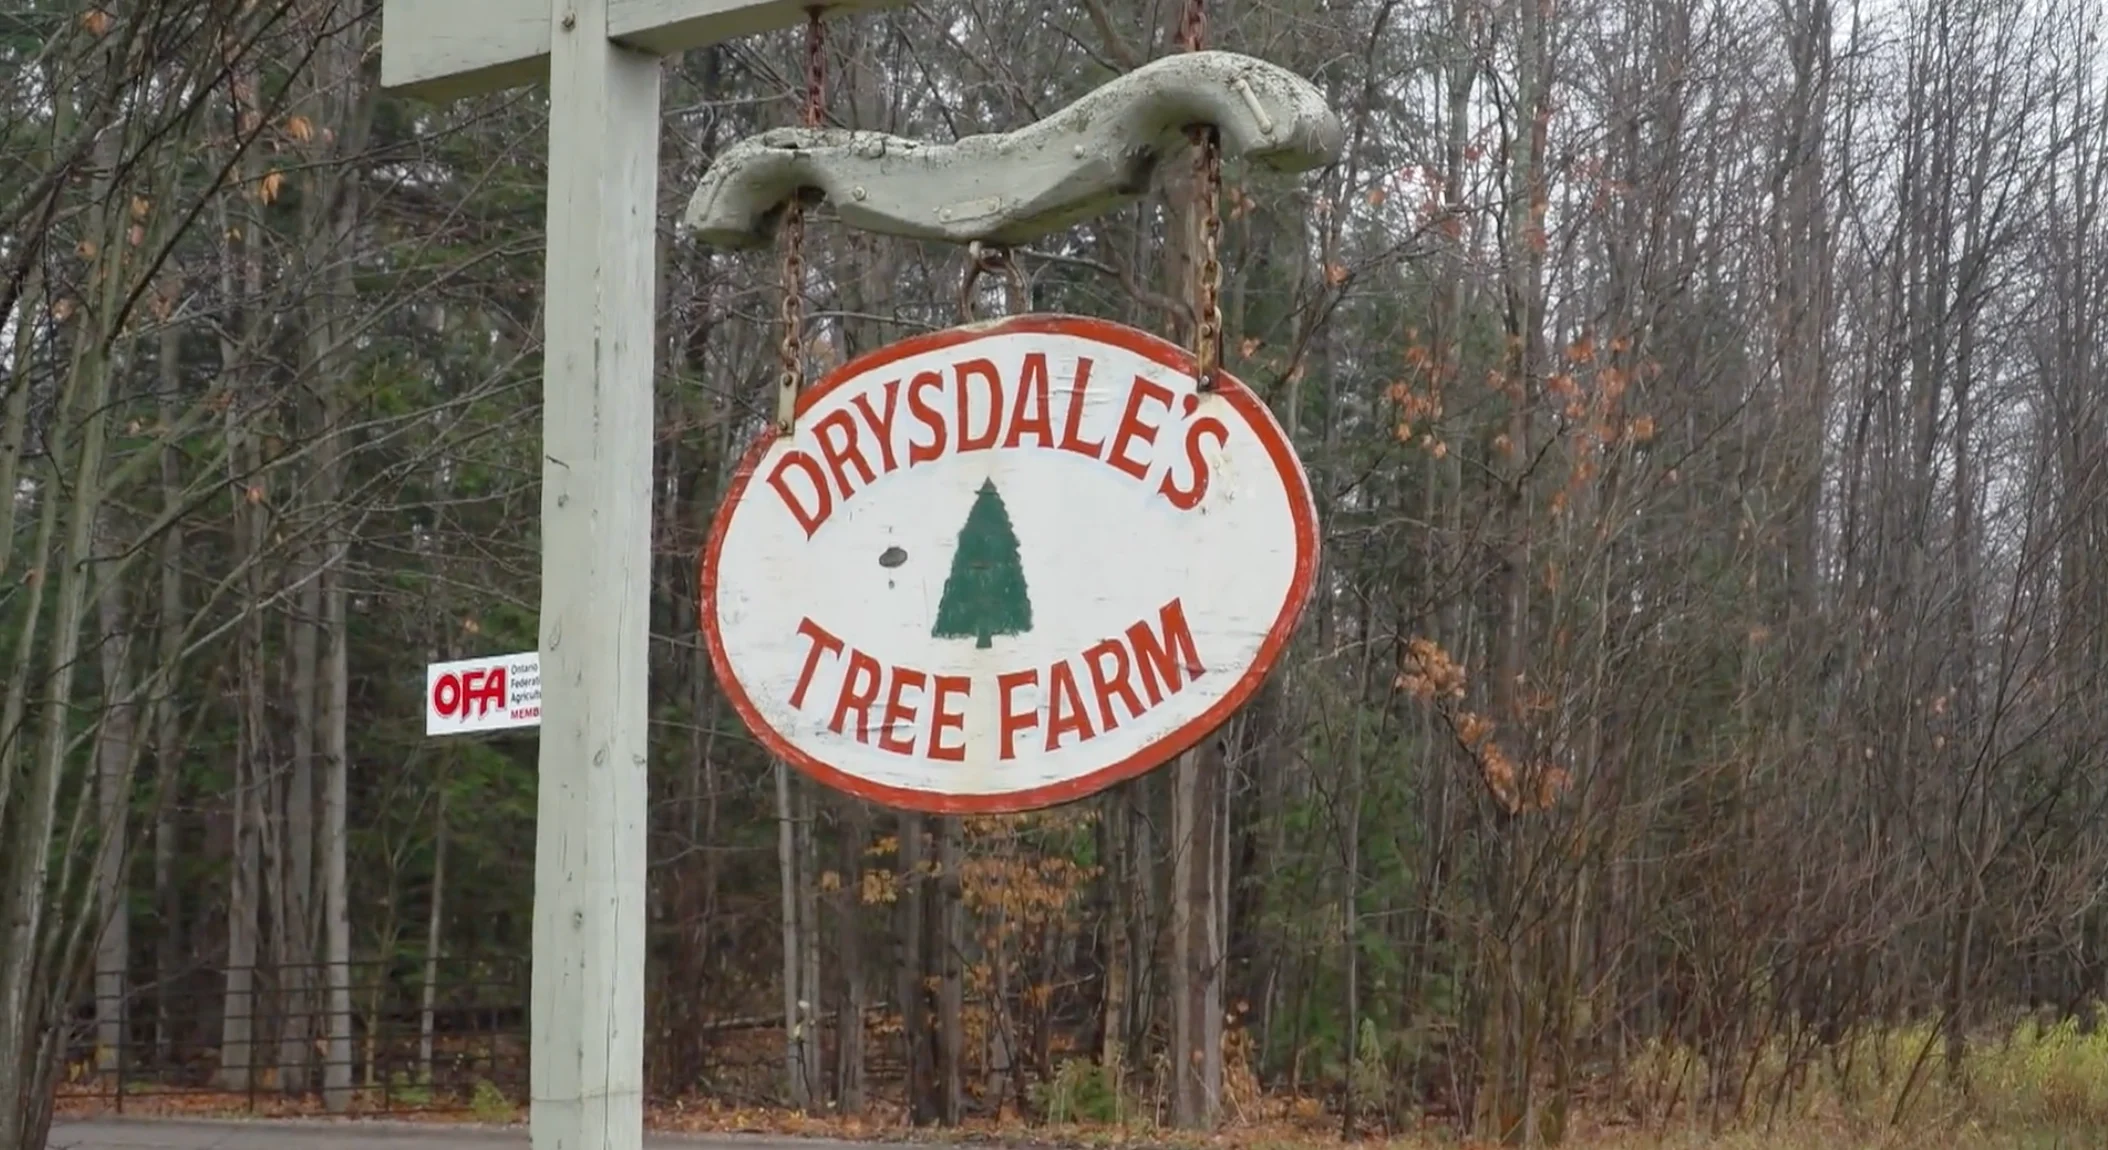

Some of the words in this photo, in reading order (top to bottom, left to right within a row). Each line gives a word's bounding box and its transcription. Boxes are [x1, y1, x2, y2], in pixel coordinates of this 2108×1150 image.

[766, 352, 1228, 540] DRYSDALE'S
[432, 666, 506, 721] OFA
[511, 663, 538, 675] Ontario
[790, 617, 972, 762] TREE
[998, 598, 1206, 761] FARM
